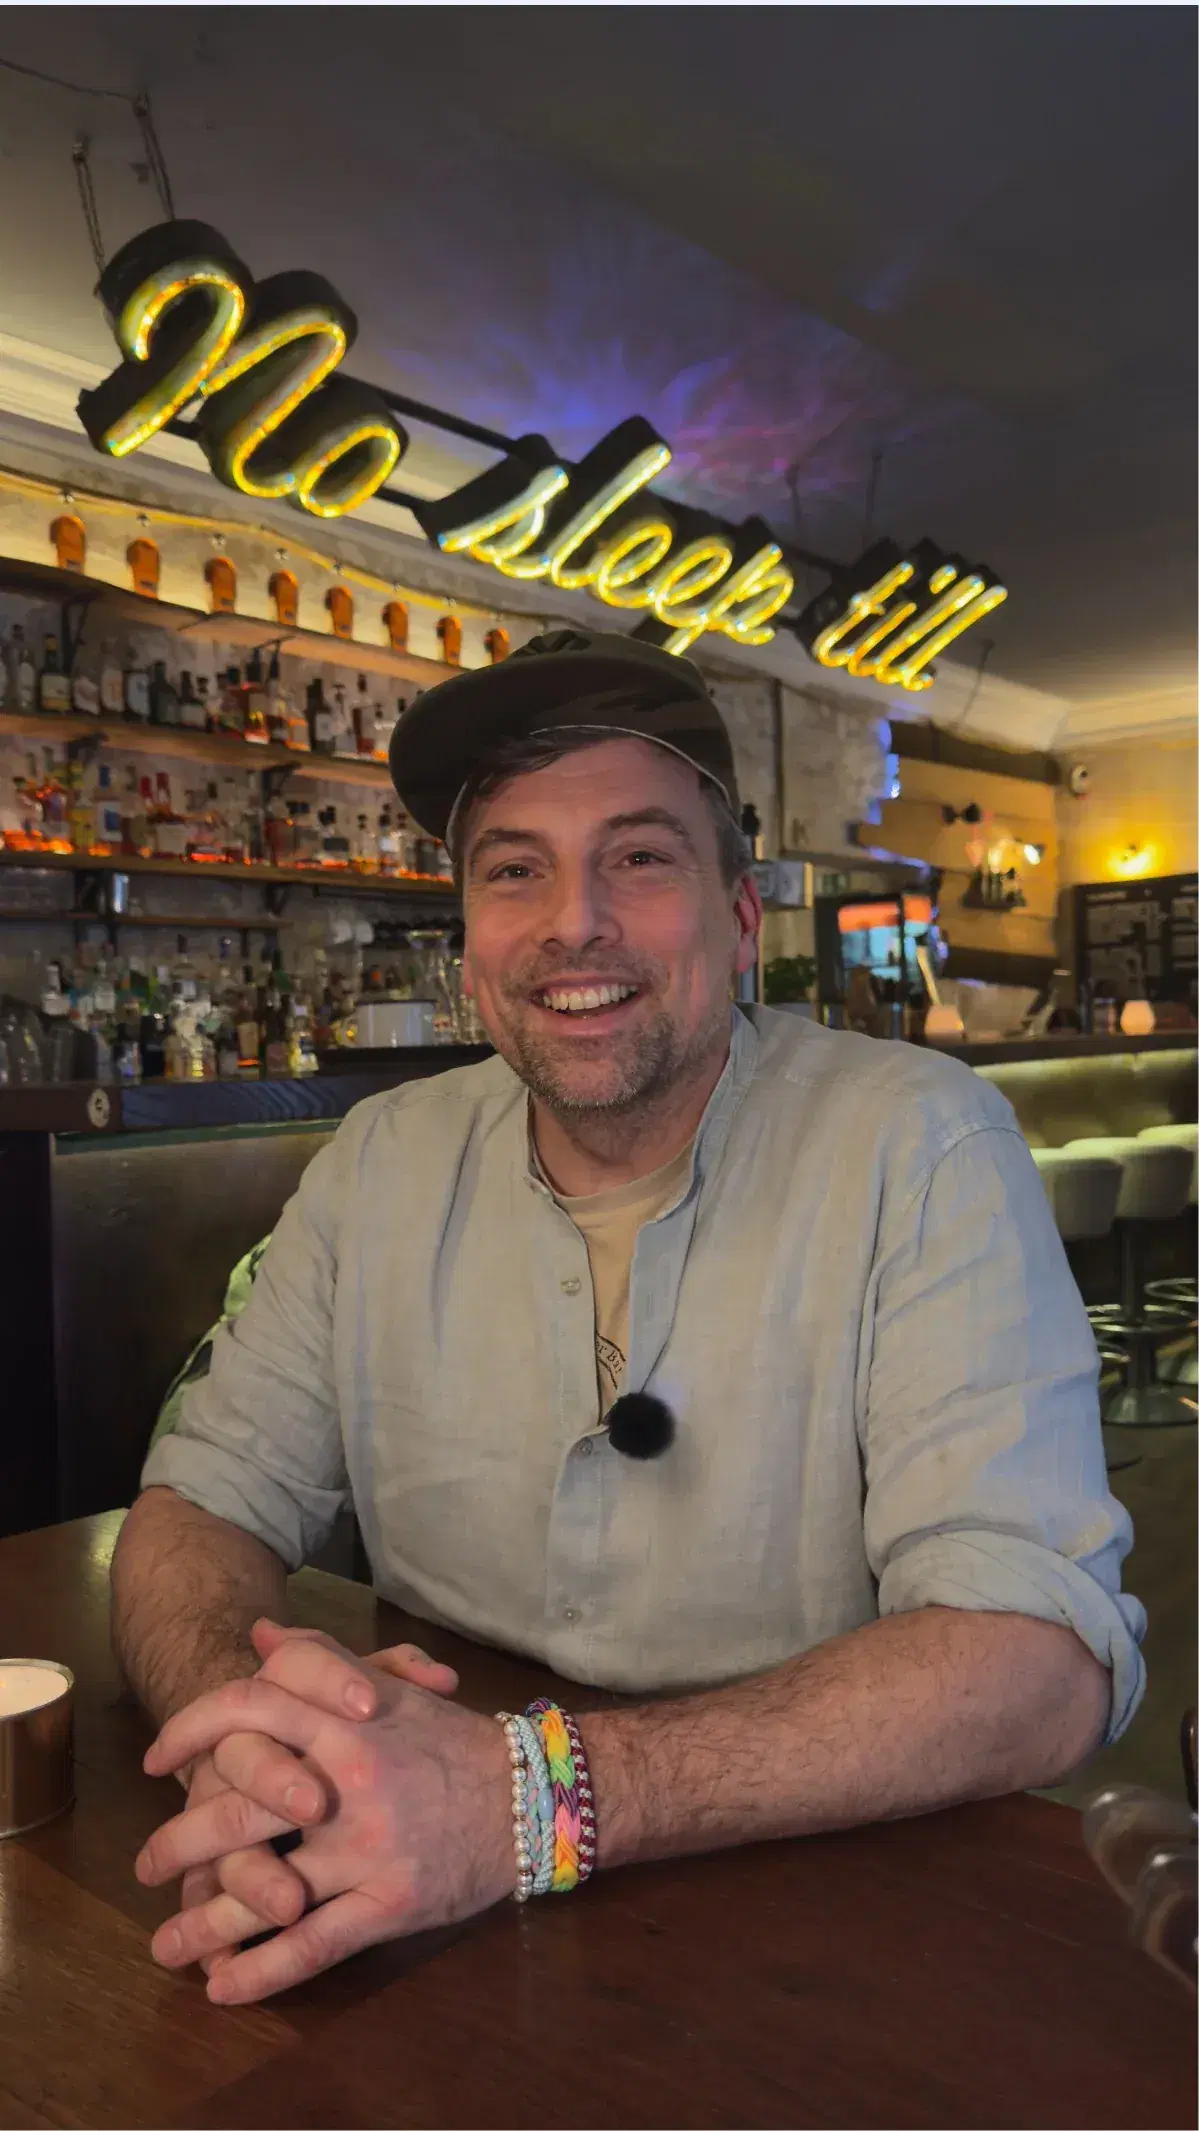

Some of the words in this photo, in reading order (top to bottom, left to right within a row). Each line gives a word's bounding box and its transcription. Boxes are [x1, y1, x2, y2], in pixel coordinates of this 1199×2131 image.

[105, 262, 402, 519] No
[439, 442, 795, 657] sleep
[812, 560, 1008, 692] till
